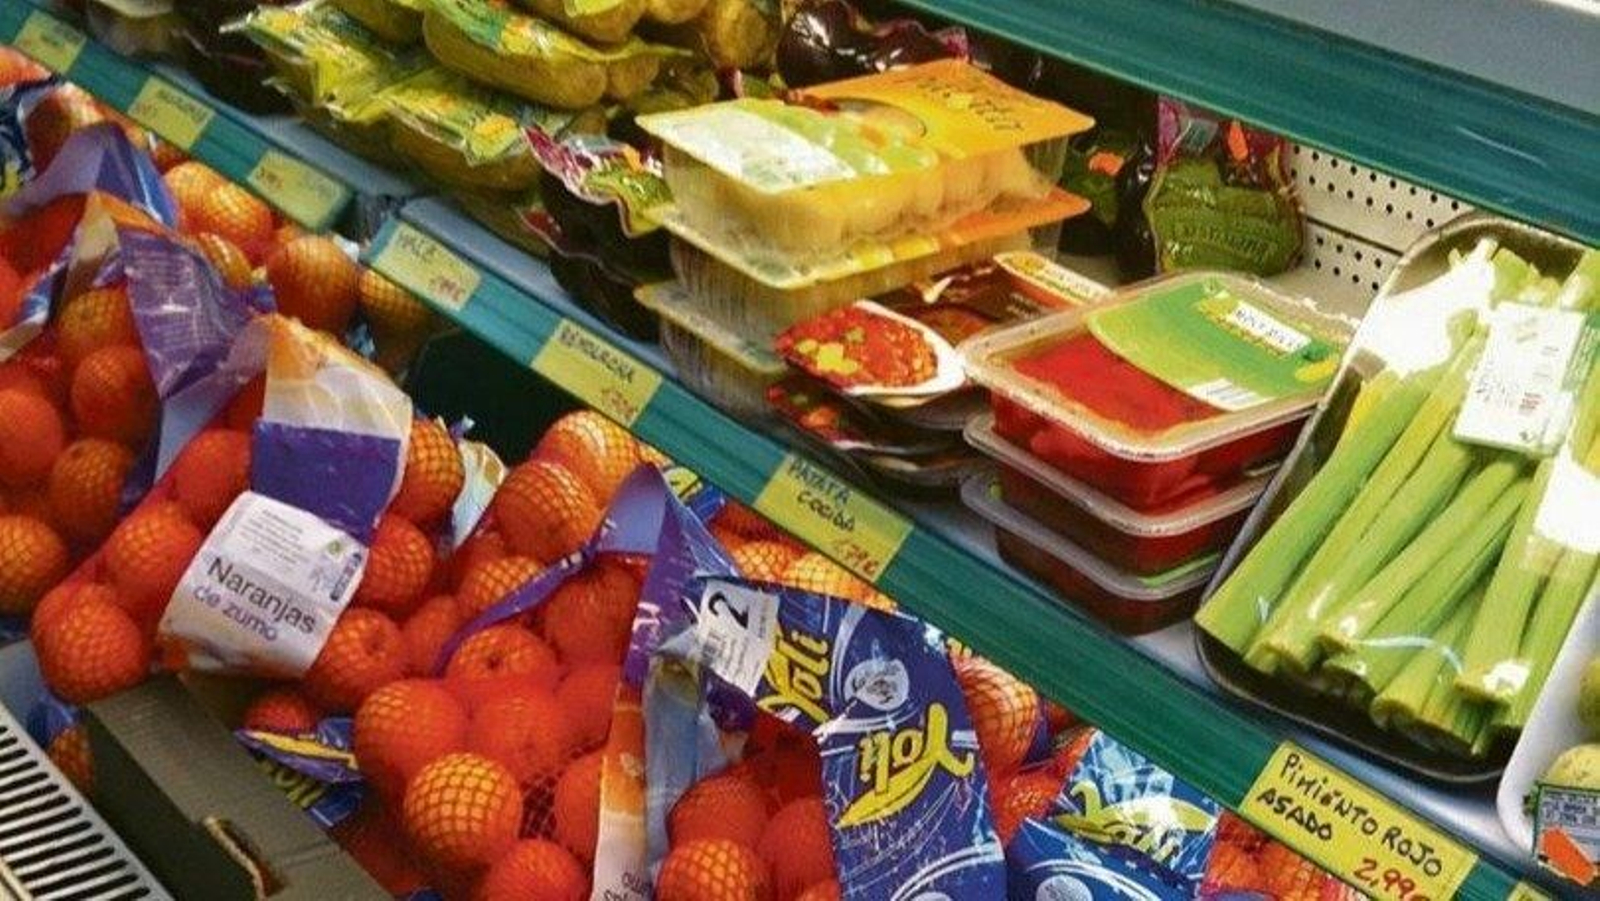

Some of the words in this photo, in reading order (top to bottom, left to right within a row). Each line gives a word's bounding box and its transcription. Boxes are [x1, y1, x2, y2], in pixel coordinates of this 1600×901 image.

[193, 585, 221, 608] de
[222, 601, 278, 641] zumo
[207, 557, 316, 634] Naranjas
[708, 590, 750, 629] 2
[846, 702, 975, 820] Yoli
[1257, 788, 1333, 841] ASADO
[1382, 826, 1443, 877] ROJO
